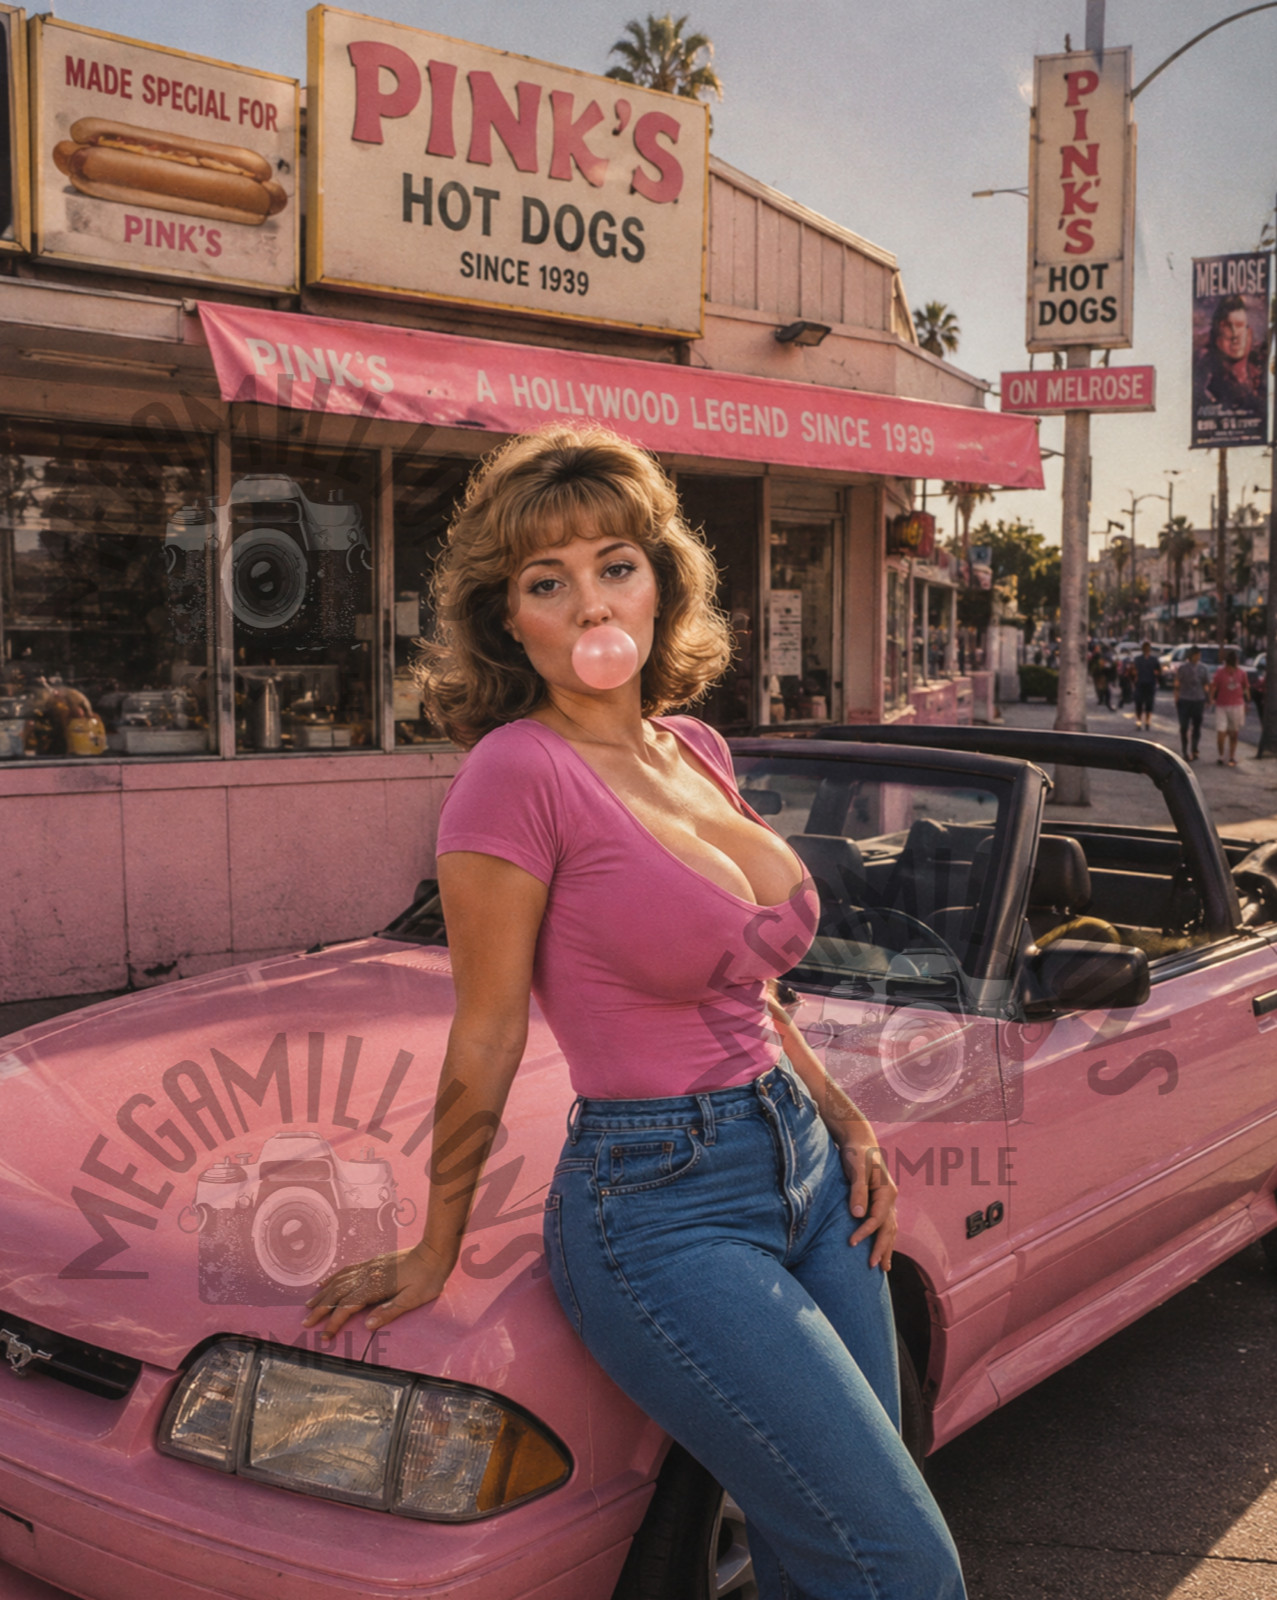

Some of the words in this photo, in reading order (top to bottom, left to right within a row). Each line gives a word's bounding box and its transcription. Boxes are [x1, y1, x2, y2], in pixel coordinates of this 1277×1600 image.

[65, 55, 133, 100] MADE
[142, 74, 231, 122] SPECIAL
[238, 97, 279, 132] FOR
[346, 40, 684, 204] PINK'S
[123, 214, 222, 258] PINK'S
[402, 172, 500, 237] HOT
[521, 195, 646, 263] DOGS
[460, 250, 530, 287] SINCE
[538, 265, 589, 296] 1939
[1048, 263, 1109, 293] HOT
[1196, 257, 1266, 299] MELROSE
[1038, 296, 1117, 327] DOGS
[246, 338, 394, 393] PINK'S
[1009, 377, 1038, 405] ON
[1045, 373, 1144, 404] MELROSE
[476, 369, 498, 405] A
[509, 374, 679, 426] HOLLYWOOD
[690, 396, 789, 439] LEGEND
[801, 411, 872, 449] SINCE
[881, 421, 935, 456] 1939
[966, 1200, 1004, 1239] 5.0
